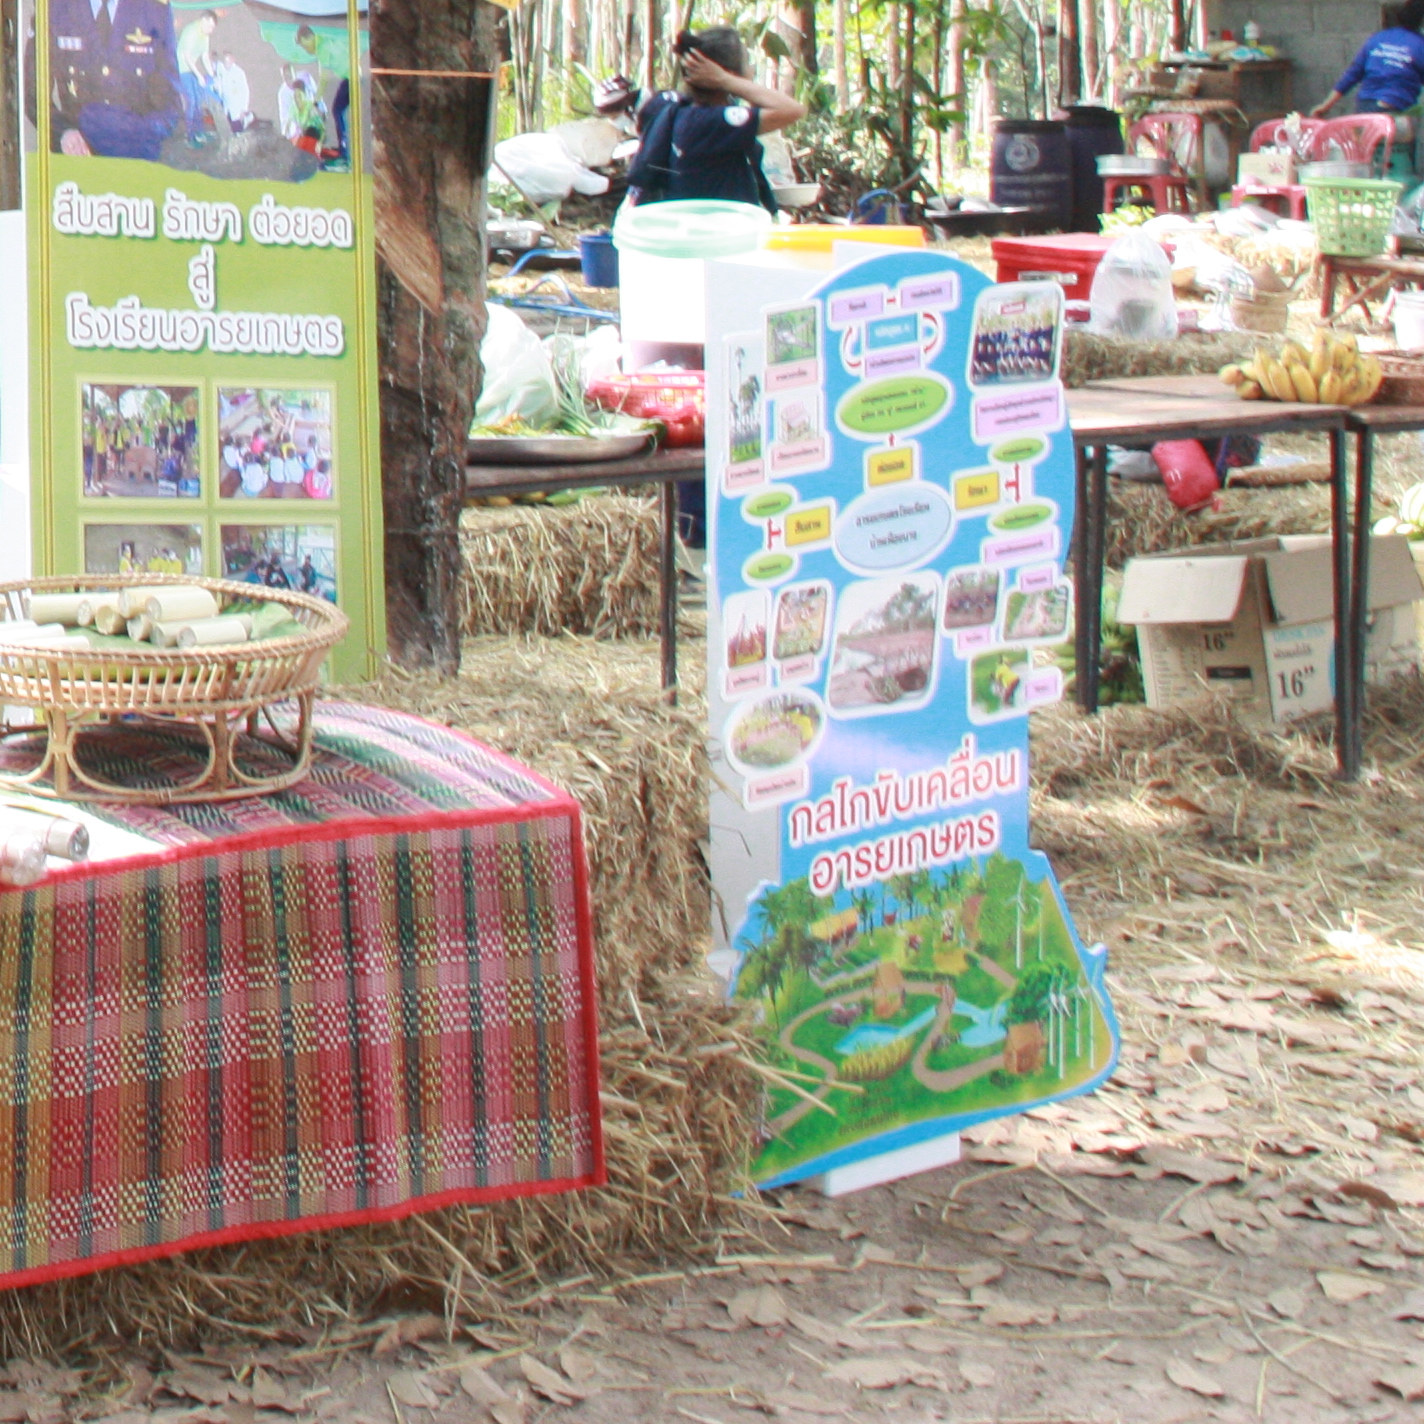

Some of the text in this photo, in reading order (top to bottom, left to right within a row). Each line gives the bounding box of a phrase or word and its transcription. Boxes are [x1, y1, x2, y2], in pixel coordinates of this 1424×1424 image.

[57, 184, 350, 246] สืบสาน รักษา ต่อยอด
[190, 246, 214, 306] สู่
[69, 294, 342, 354] โรงเรียนอารยเกษตร
[790, 737, 1017, 841] กลไกขับเคลื่อน
[812, 814, 996, 889] อารยเกษตร
